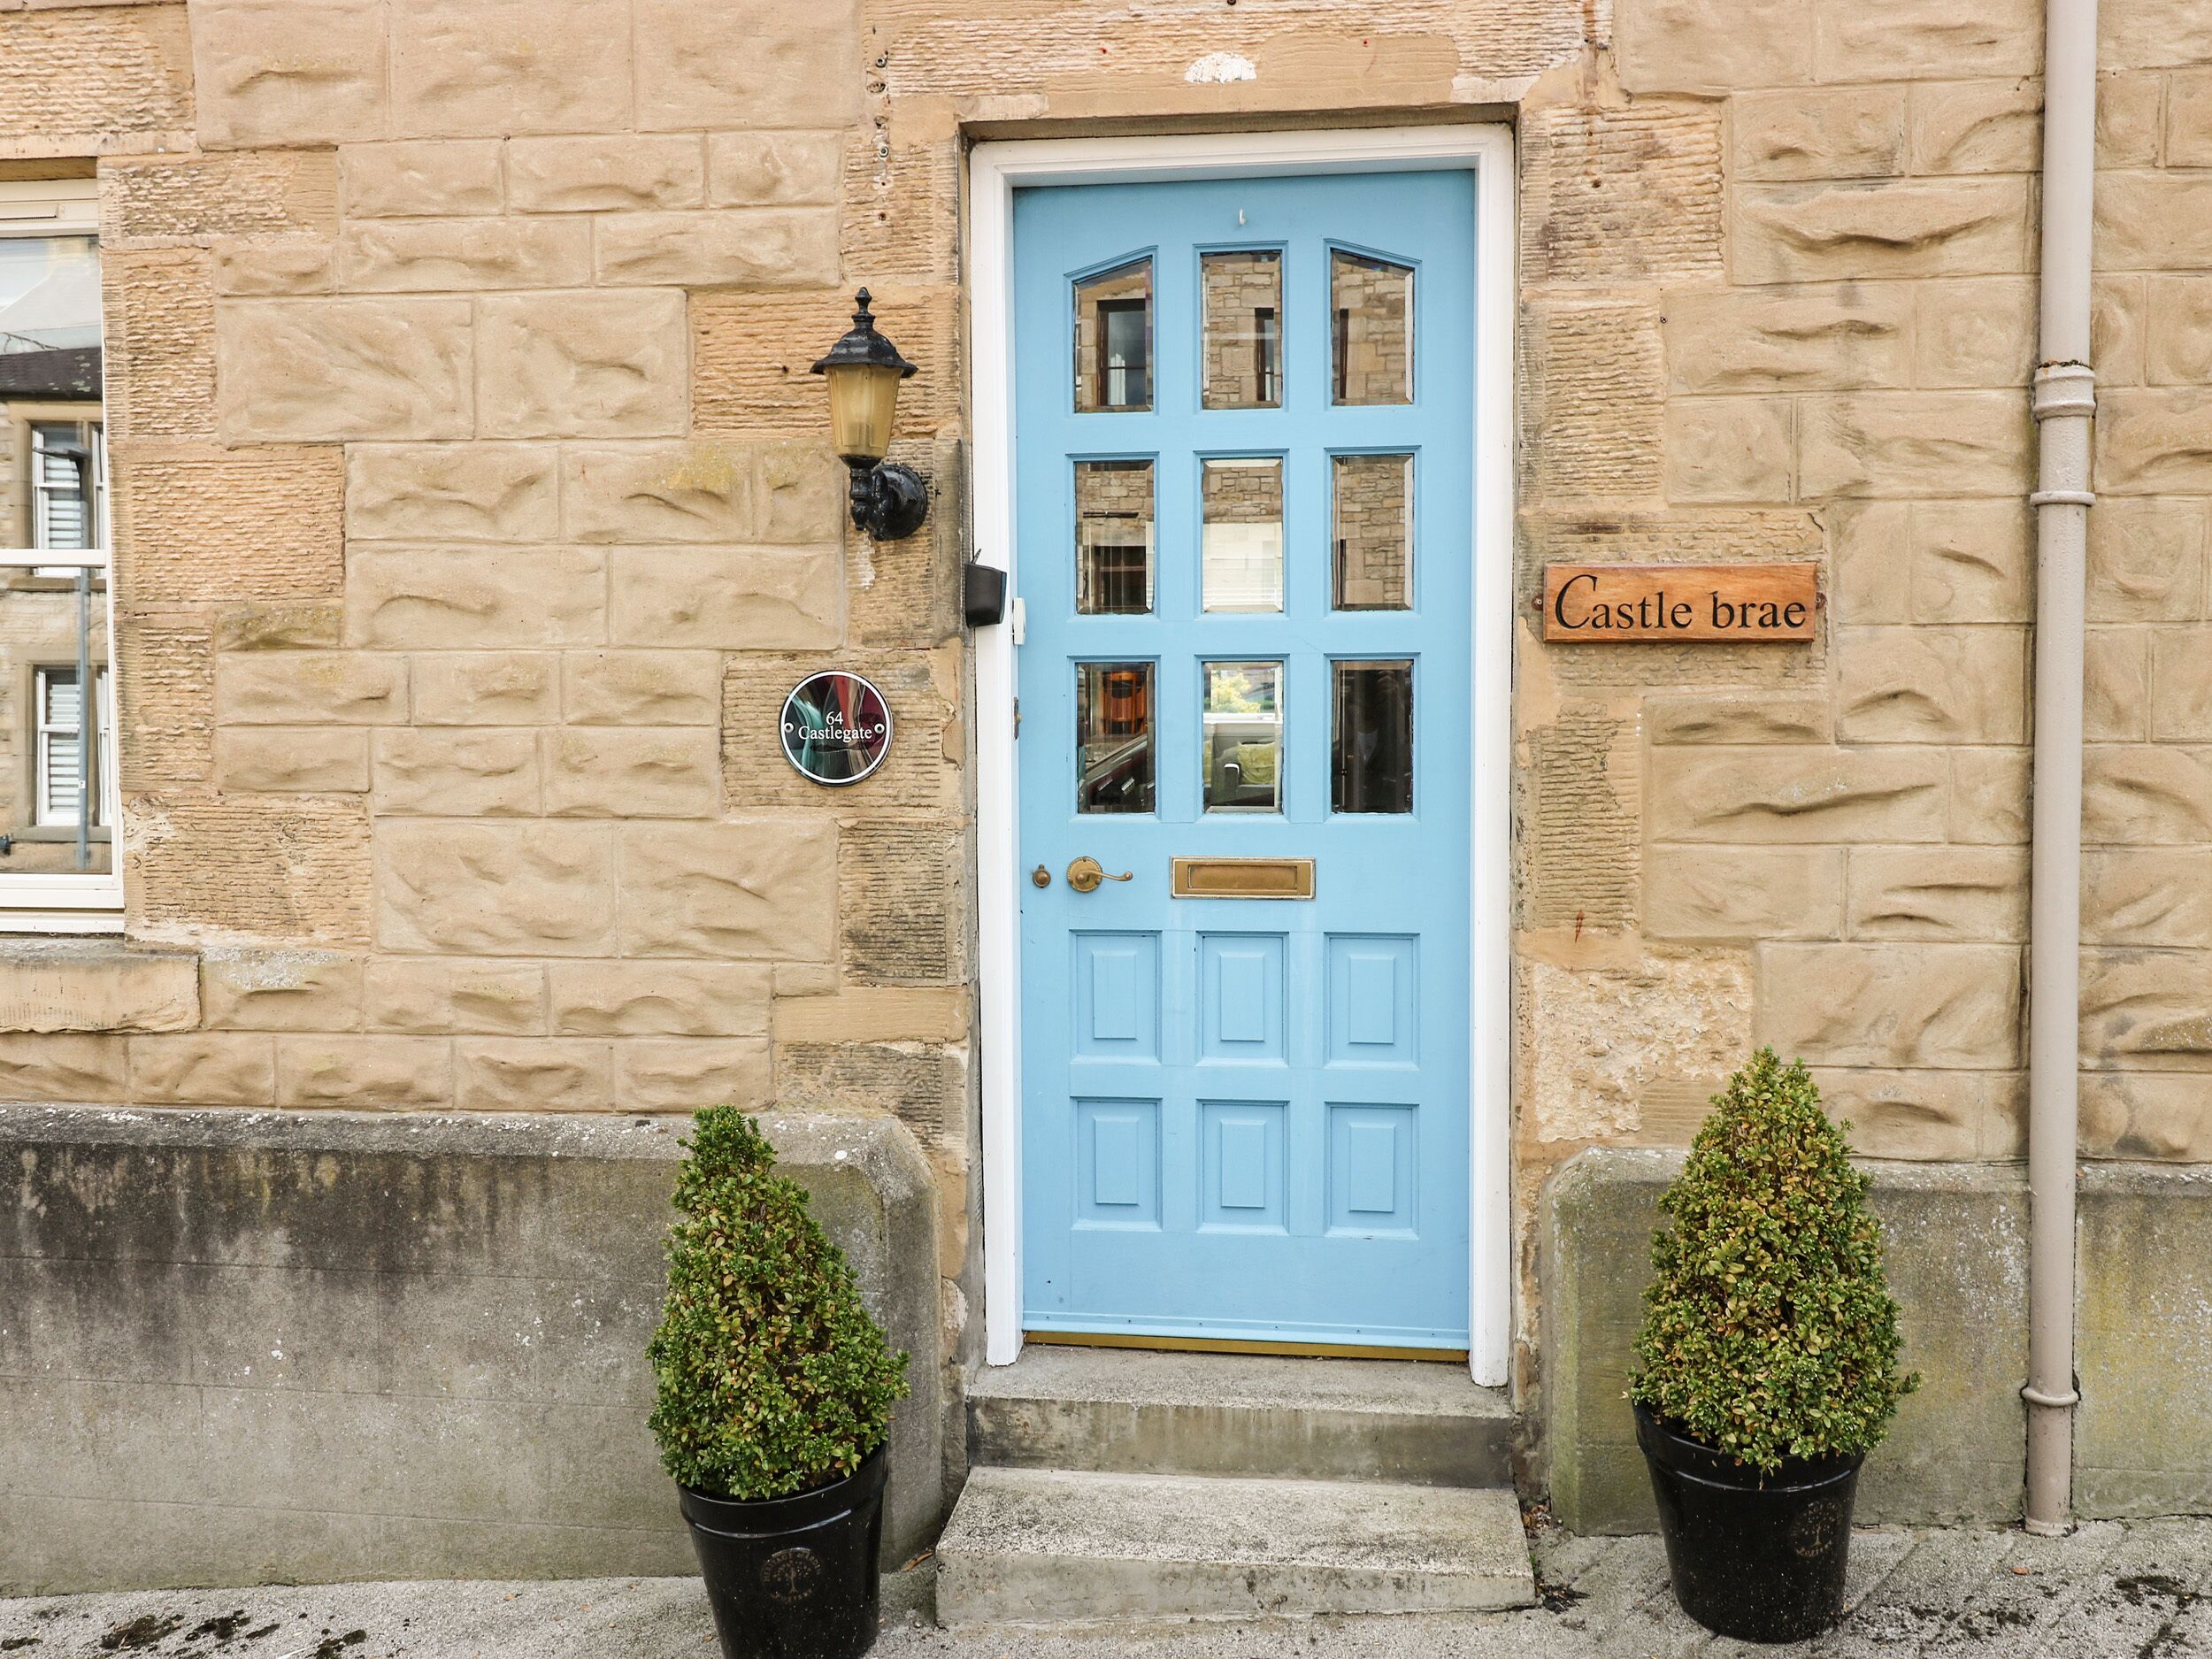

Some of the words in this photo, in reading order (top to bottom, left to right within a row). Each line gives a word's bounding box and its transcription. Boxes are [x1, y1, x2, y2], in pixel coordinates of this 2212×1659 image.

[1555, 573, 1693, 630] Castle
[1709, 590, 1807, 630] brae
[826, 710, 844, 726] 64
[798, 726, 872, 743] Castlegate
